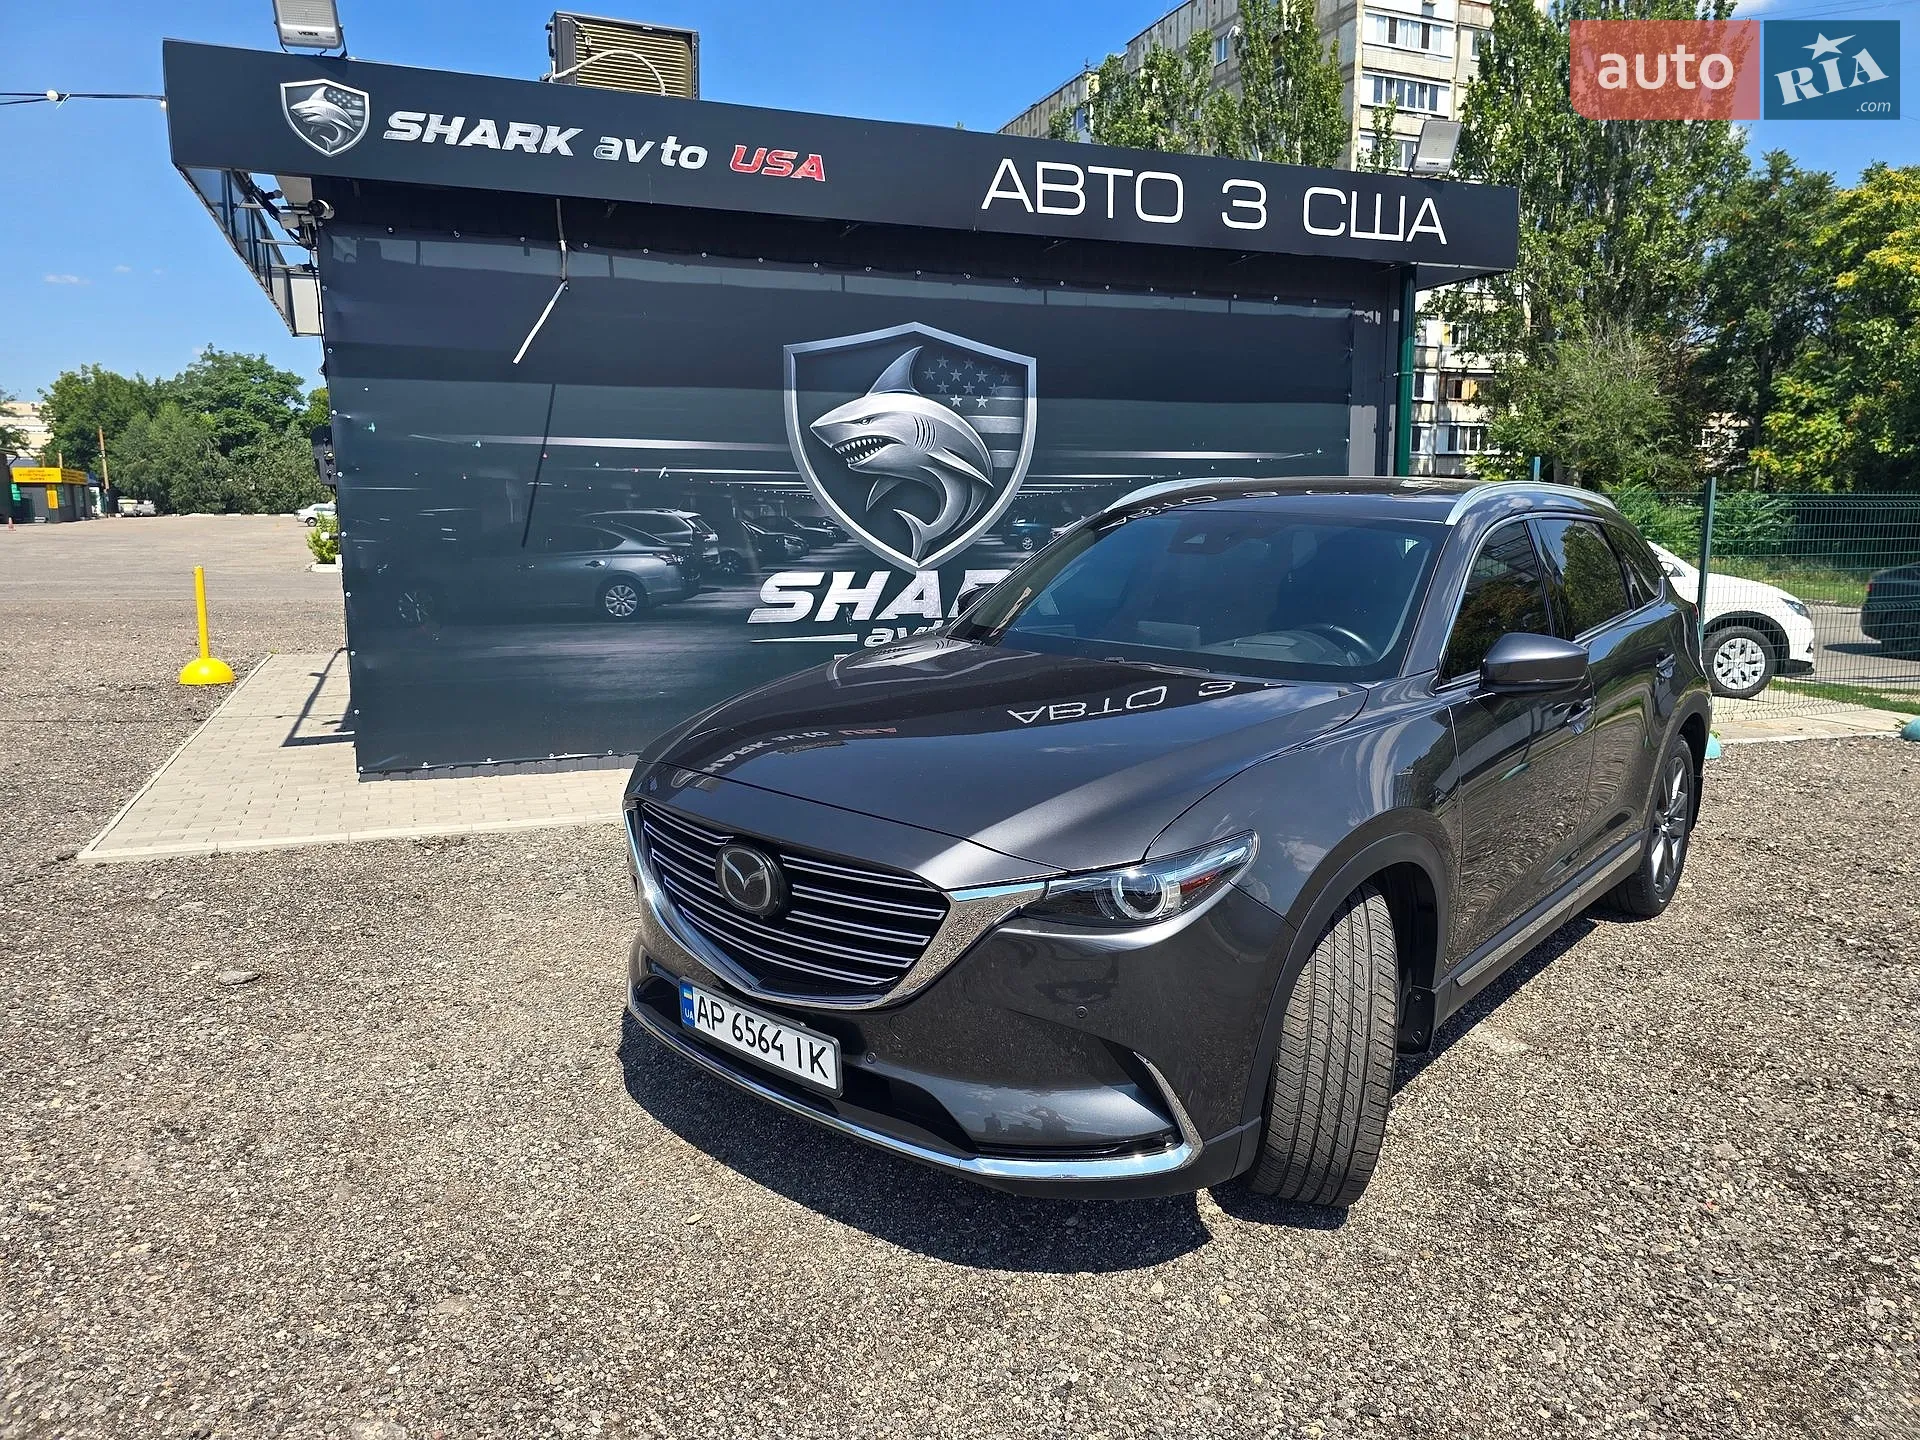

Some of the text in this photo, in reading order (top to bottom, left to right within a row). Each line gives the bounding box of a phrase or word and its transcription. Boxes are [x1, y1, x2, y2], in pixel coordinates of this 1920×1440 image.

[383, 110, 827, 182] SHARK avto USA
[980, 157, 1185, 225] АВТО
[1302, 186, 1448, 246] США
[747, 569, 1012, 624] SHA
[684, 1008, 695, 1021] UA
[697, 995, 829, 1080] AP 6564 IK
